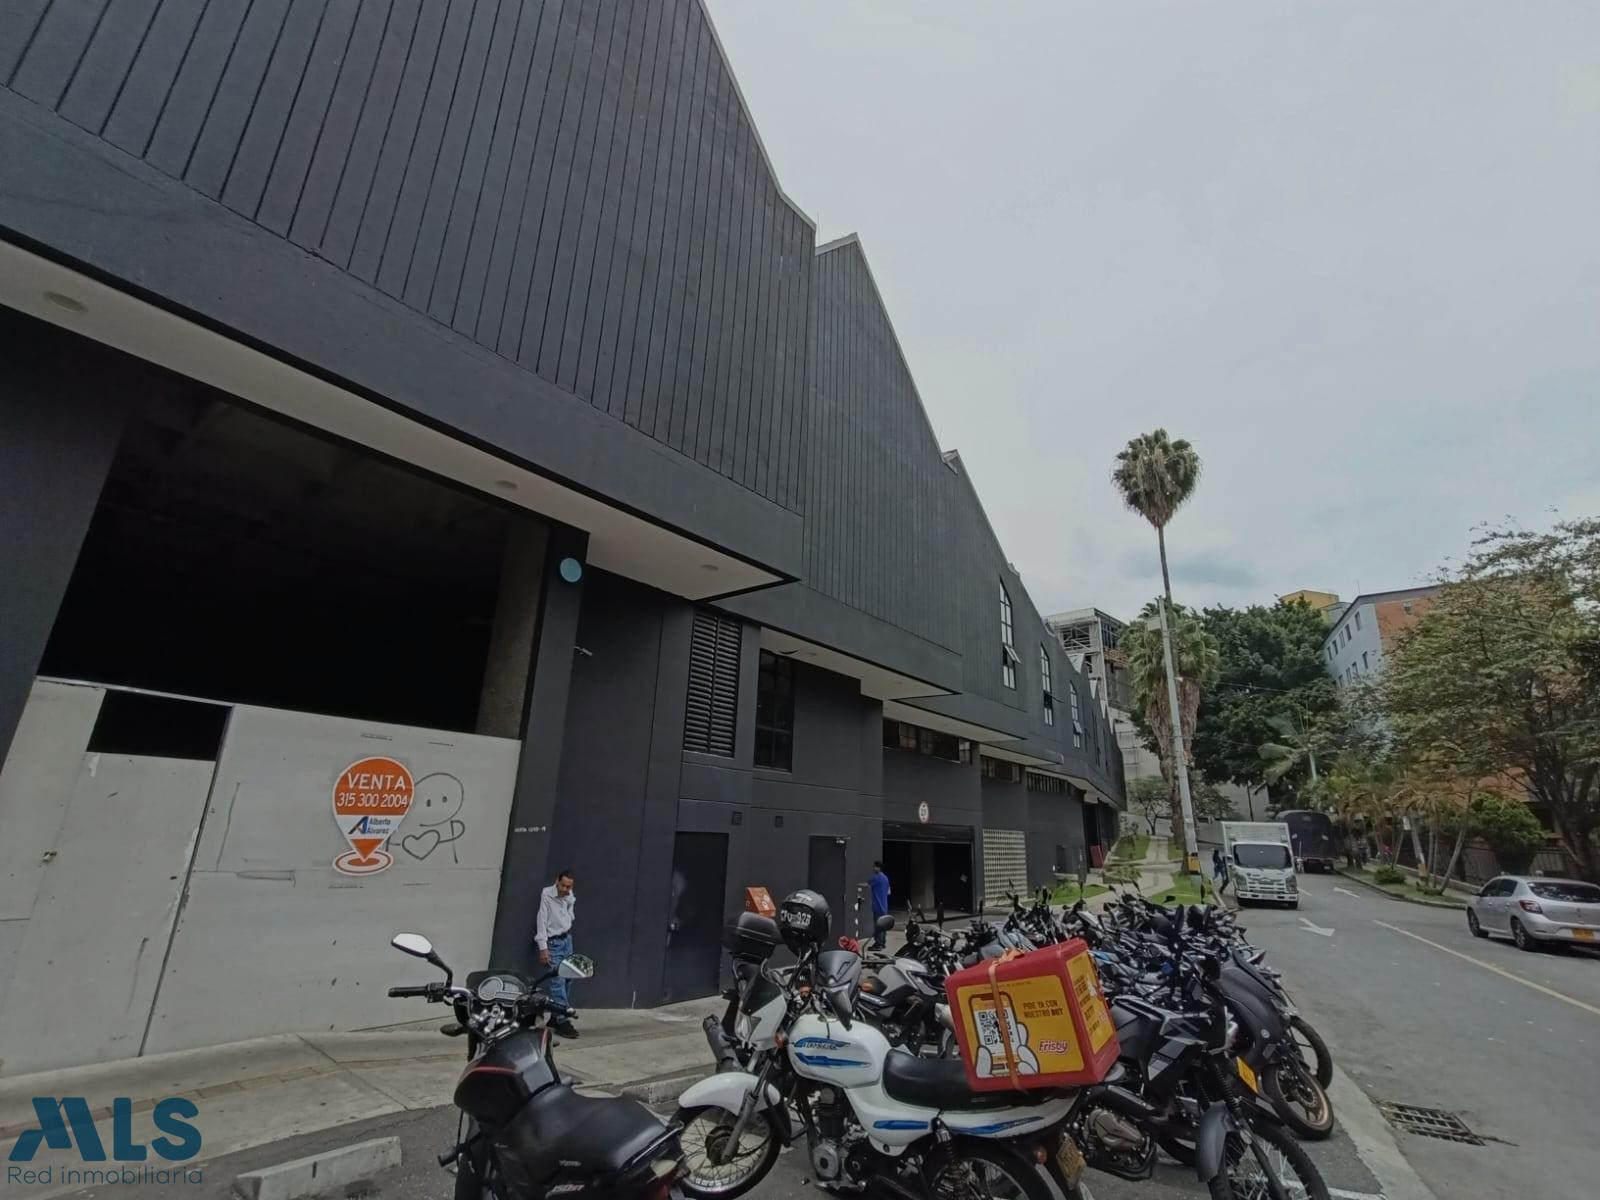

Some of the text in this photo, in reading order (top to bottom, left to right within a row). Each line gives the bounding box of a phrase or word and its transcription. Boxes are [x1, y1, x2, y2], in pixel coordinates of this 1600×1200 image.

[348, 773, 406, 790] VENTA
[337, 792, 408, 808] 315 300 2004
[1038, 1039, 1068, 1054] Frisby
